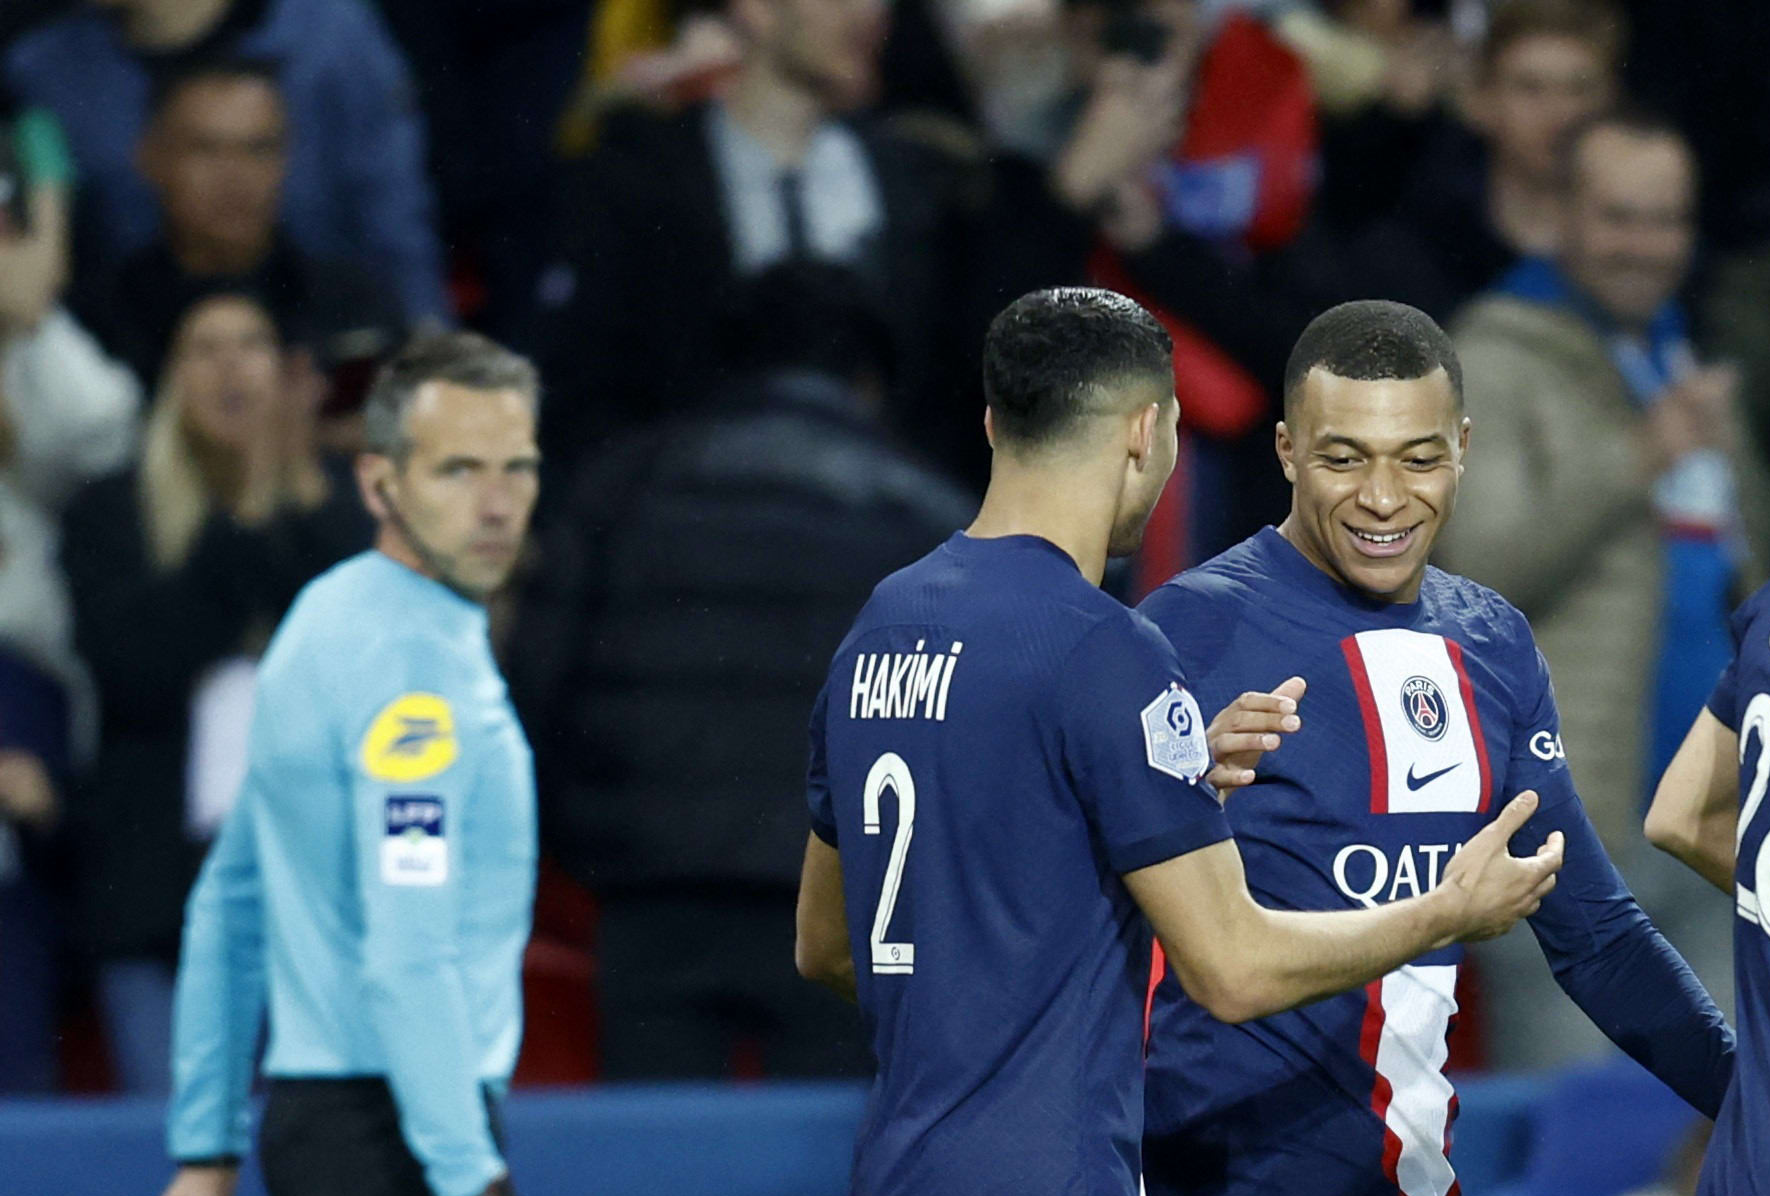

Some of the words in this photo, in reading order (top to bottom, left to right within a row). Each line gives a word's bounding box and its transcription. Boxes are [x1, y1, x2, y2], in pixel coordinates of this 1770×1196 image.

[1404, 680, 1435, 697] PARIS
[863, 752, 915, 974] 2
[1332, 842, 1463, 910] QAT
